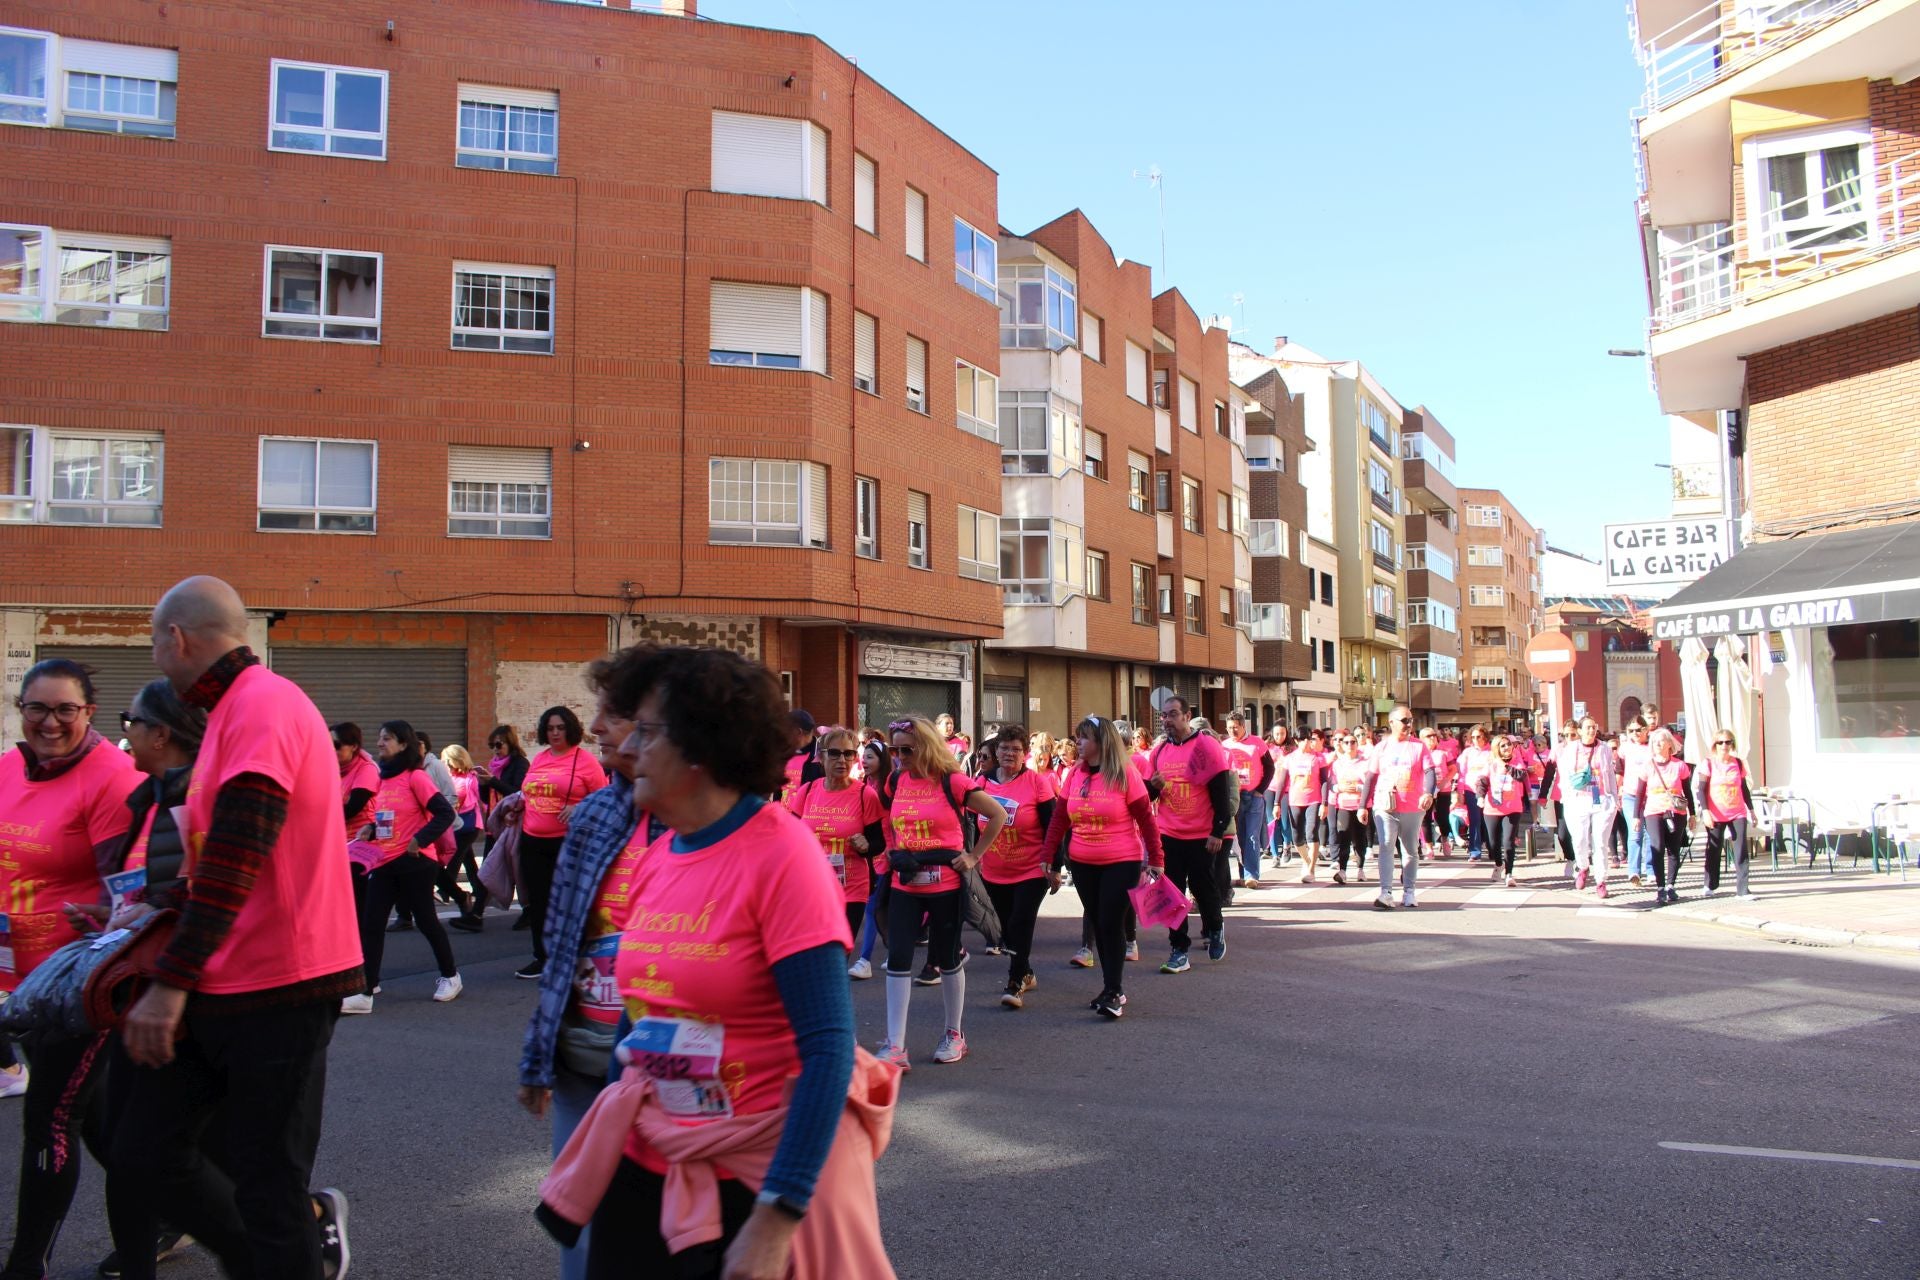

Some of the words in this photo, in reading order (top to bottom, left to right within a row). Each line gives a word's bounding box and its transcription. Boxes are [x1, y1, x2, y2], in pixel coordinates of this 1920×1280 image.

[1613, 528, 1666, 549] CAFE
[1676, 524, 1717, 545] BAR
[1610, 557, 1636, 577] LA
[1656, 614, 1694, 638] CAFÉ
[1696, 614, 1730, 635] BAR
[1738, 607, 1765, 631] LA
[1769, 598, 1855, 627] GARITA
[8, 650, 31, 658] ALQUILA
